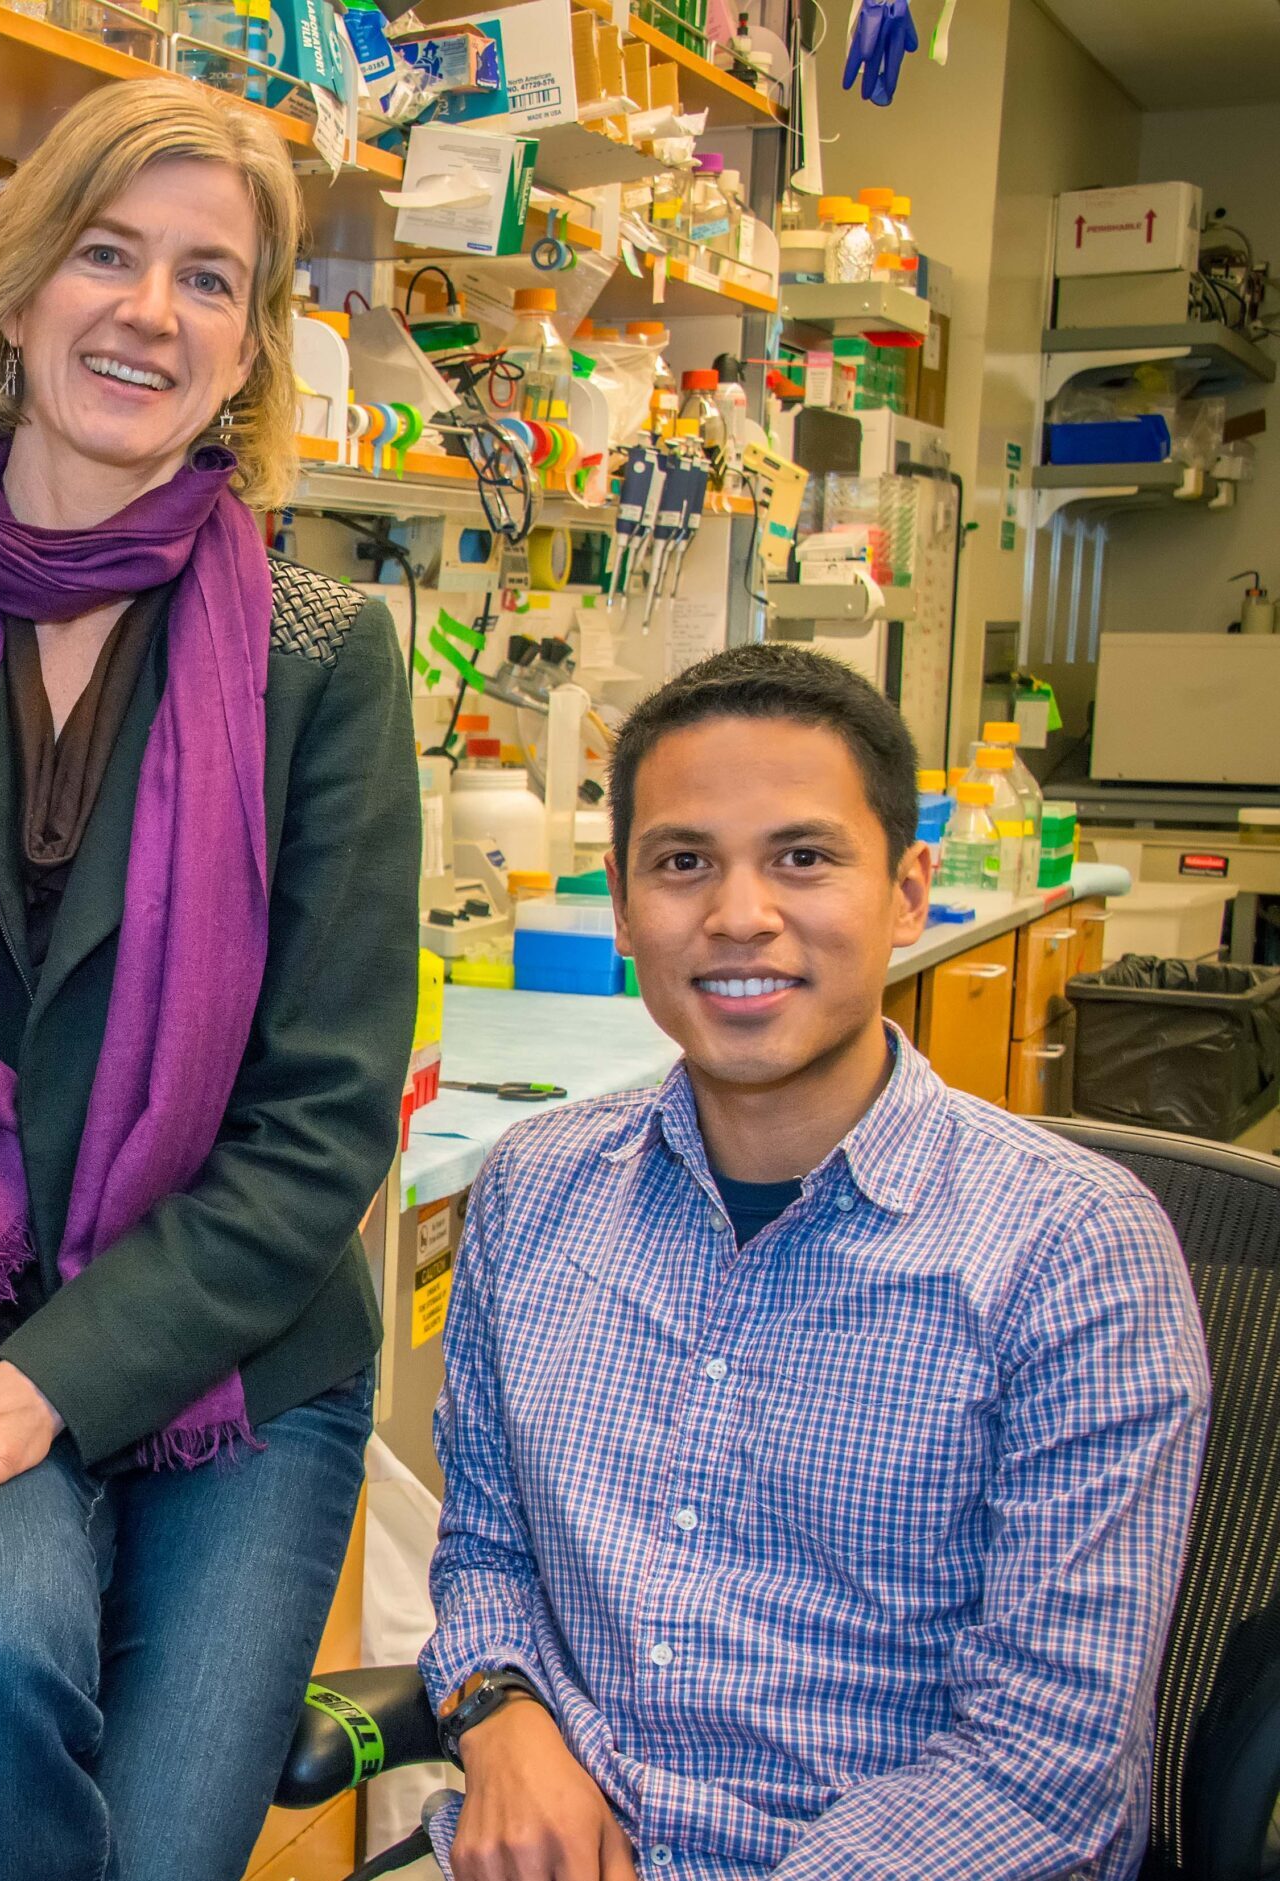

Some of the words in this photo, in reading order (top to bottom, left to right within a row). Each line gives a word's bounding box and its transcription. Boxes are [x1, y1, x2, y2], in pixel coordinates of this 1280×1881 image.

[301, 20, 313, 49] FILM
[507, 78, 524, 86] North
[525, 72, 552, 83] American
[527, 113, 543, 121] MADE
[549, 110, 562, 118] USA
[1086, 222, 1142, 233] PERISHABLE
